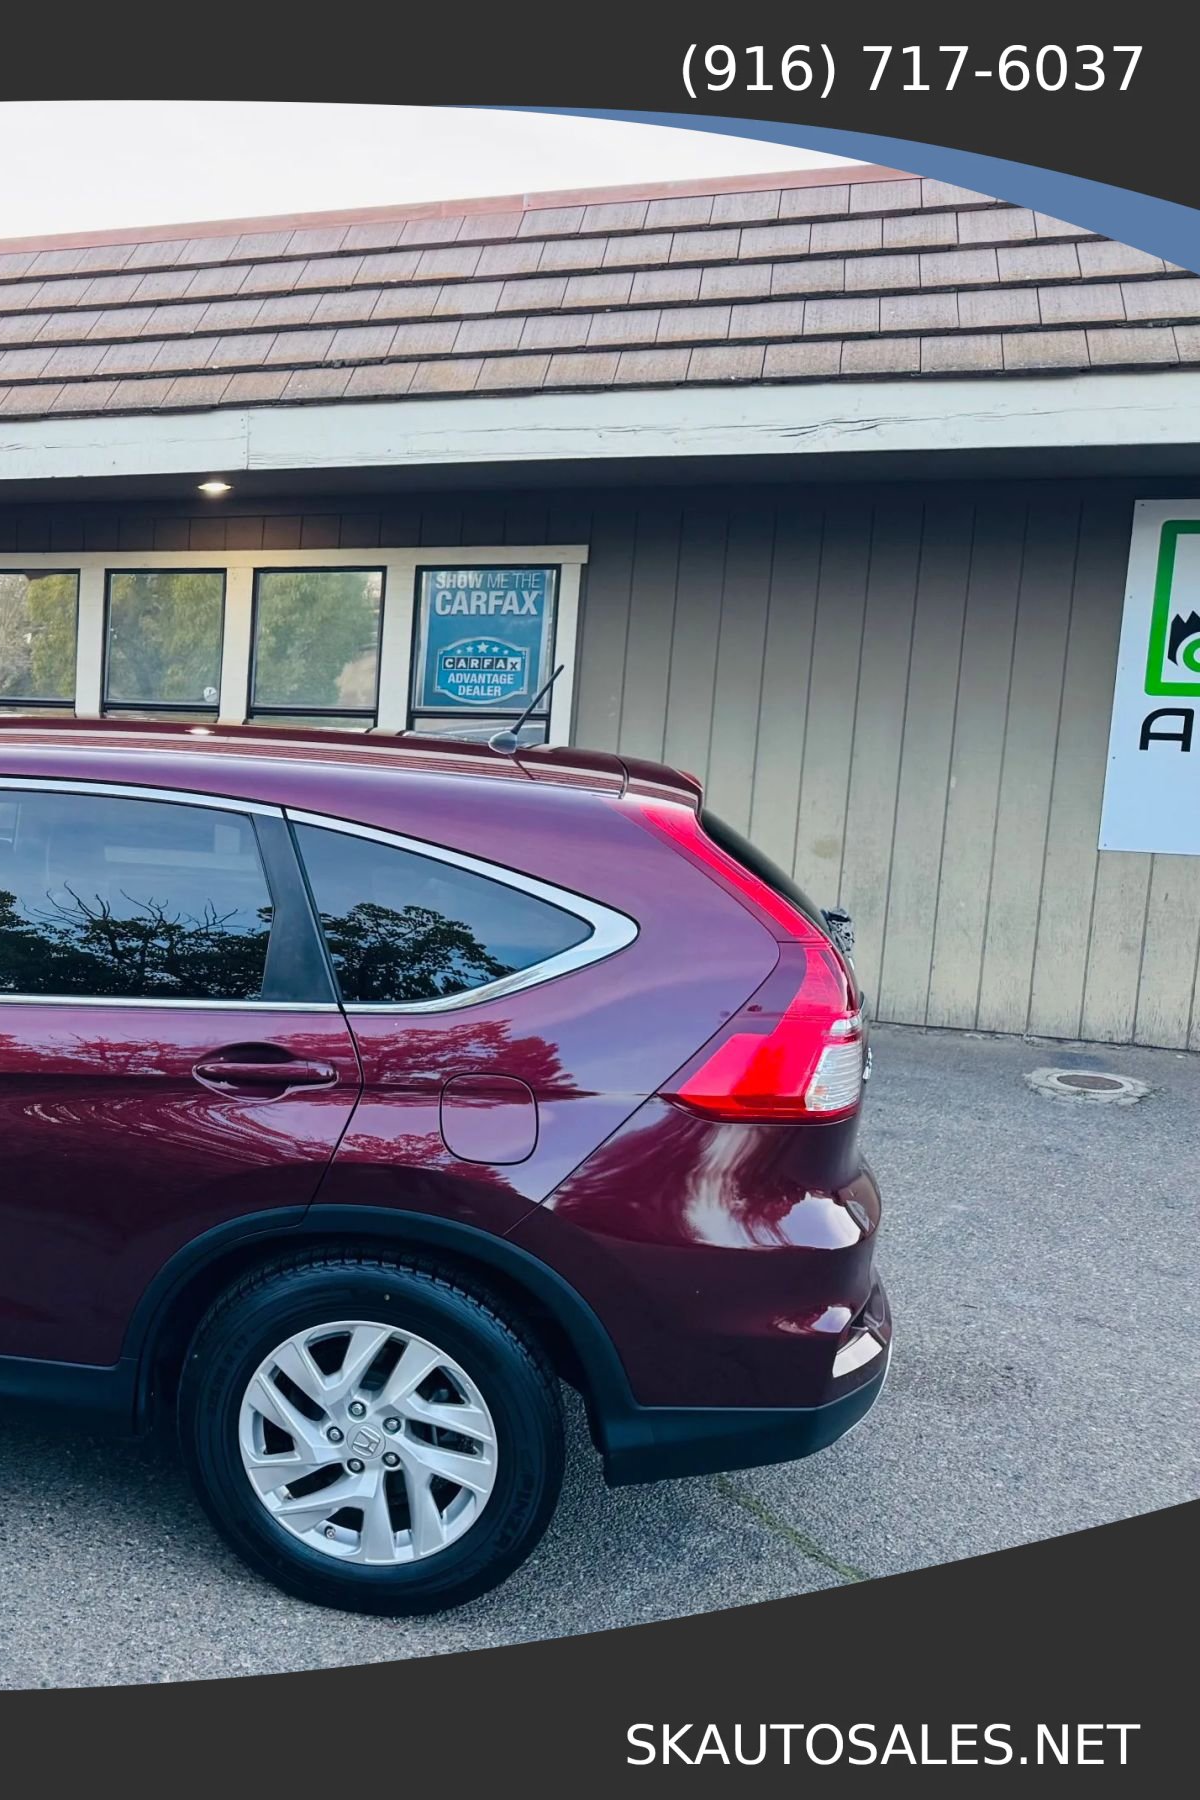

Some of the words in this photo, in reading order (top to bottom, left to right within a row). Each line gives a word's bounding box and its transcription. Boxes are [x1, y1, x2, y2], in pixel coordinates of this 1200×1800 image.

[435, 572, 484, 589] SHOW
[487, 573, 509, 589] ME
[513, 572, 541, 588] THE
[435, 590, 538, 615] CARFAX
[443, 657, 521, 671] CARFAX
[447, 672, 514, 684] ADVANTAGE
[457, 685, 502, 697] DEALER
